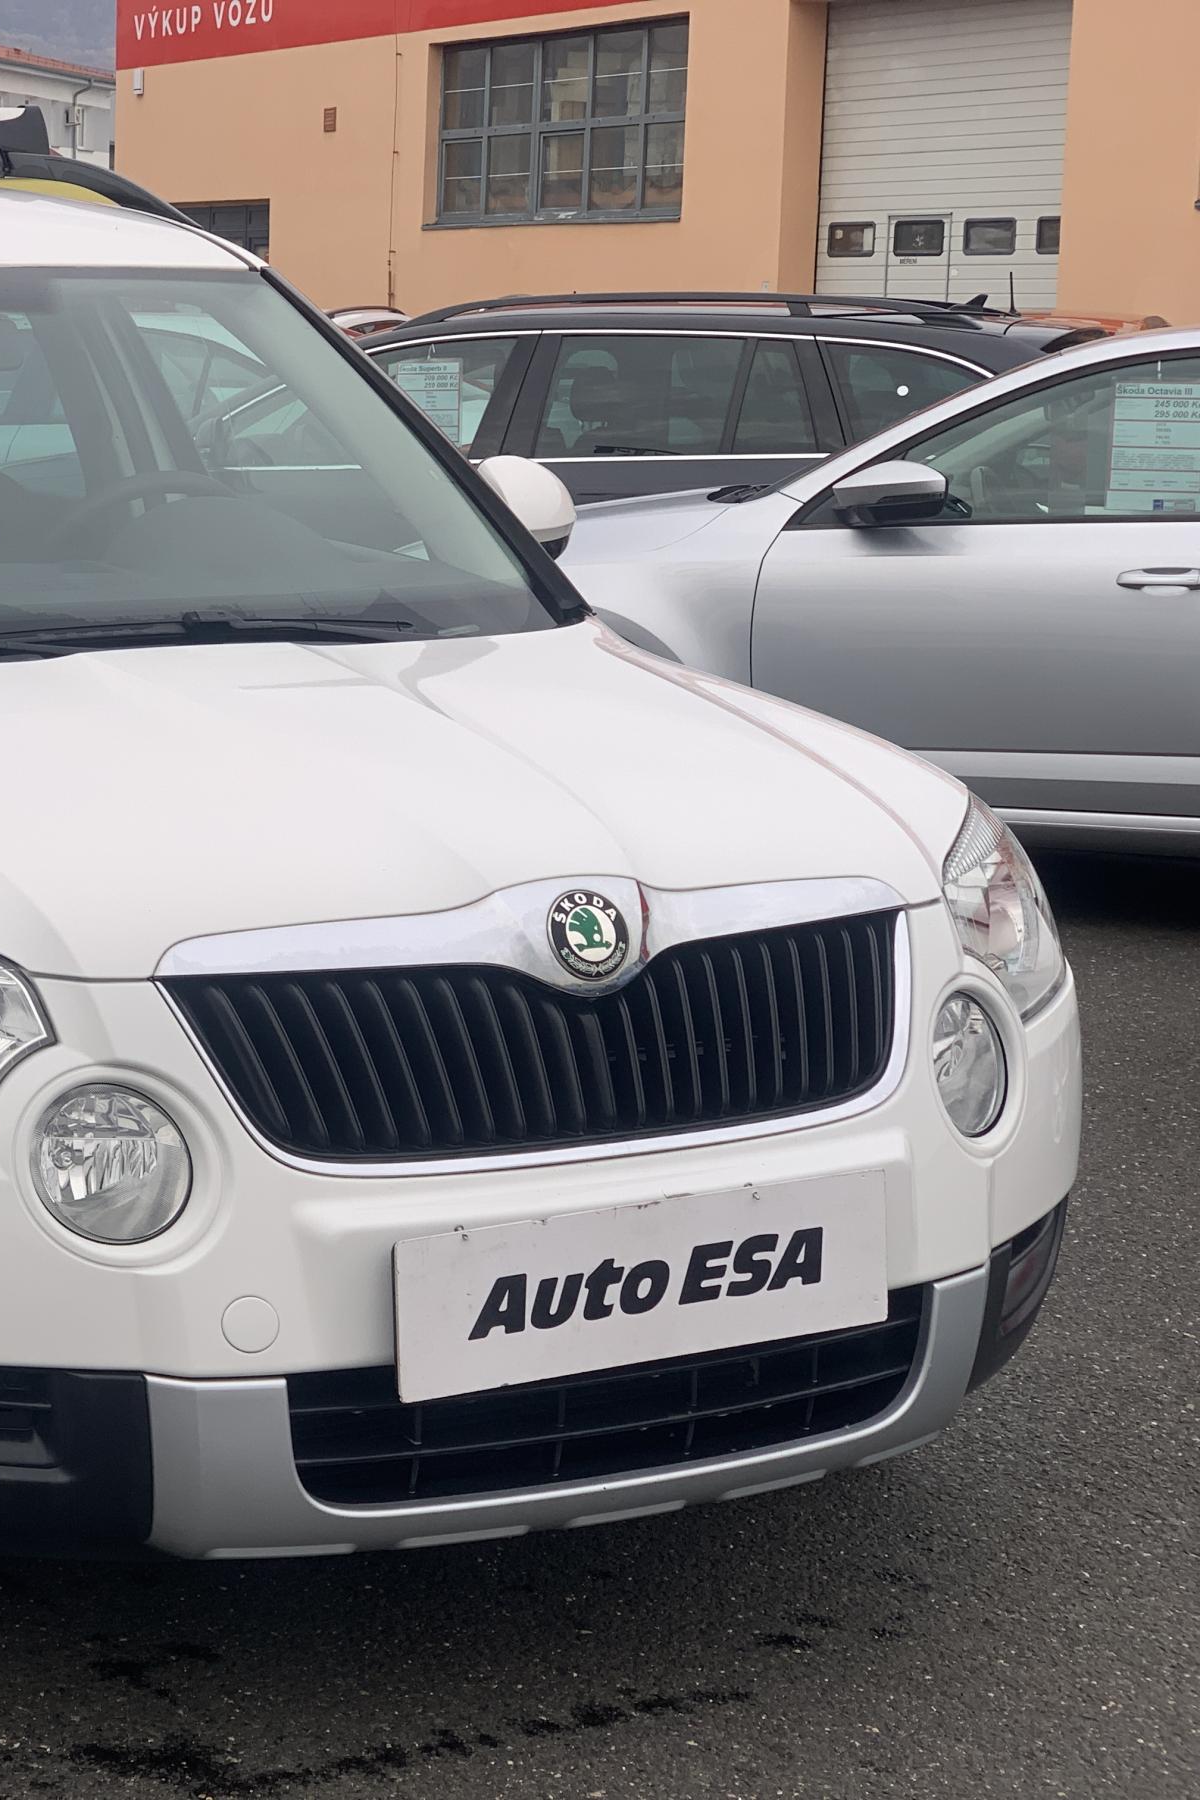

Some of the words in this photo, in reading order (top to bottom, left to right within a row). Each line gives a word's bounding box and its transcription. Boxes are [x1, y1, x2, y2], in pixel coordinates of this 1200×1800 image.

[134, 5, 202, 41] VÝKUP
[1117, 385, 1145, 395] Škoda
[1147, 386, 1182, 396] Octavia
[1154, 400, 1171, 409] 245
[1173, 400, 1189, 409] 000
[1154, 410, 1170, 419] 295
[1172, 410, 1189, 419] 000
[552, 893, 617, 924] ŠKODA
[468, 1259, 669, 1340] Auto
[679, 1227, 823, 1305] ESA
